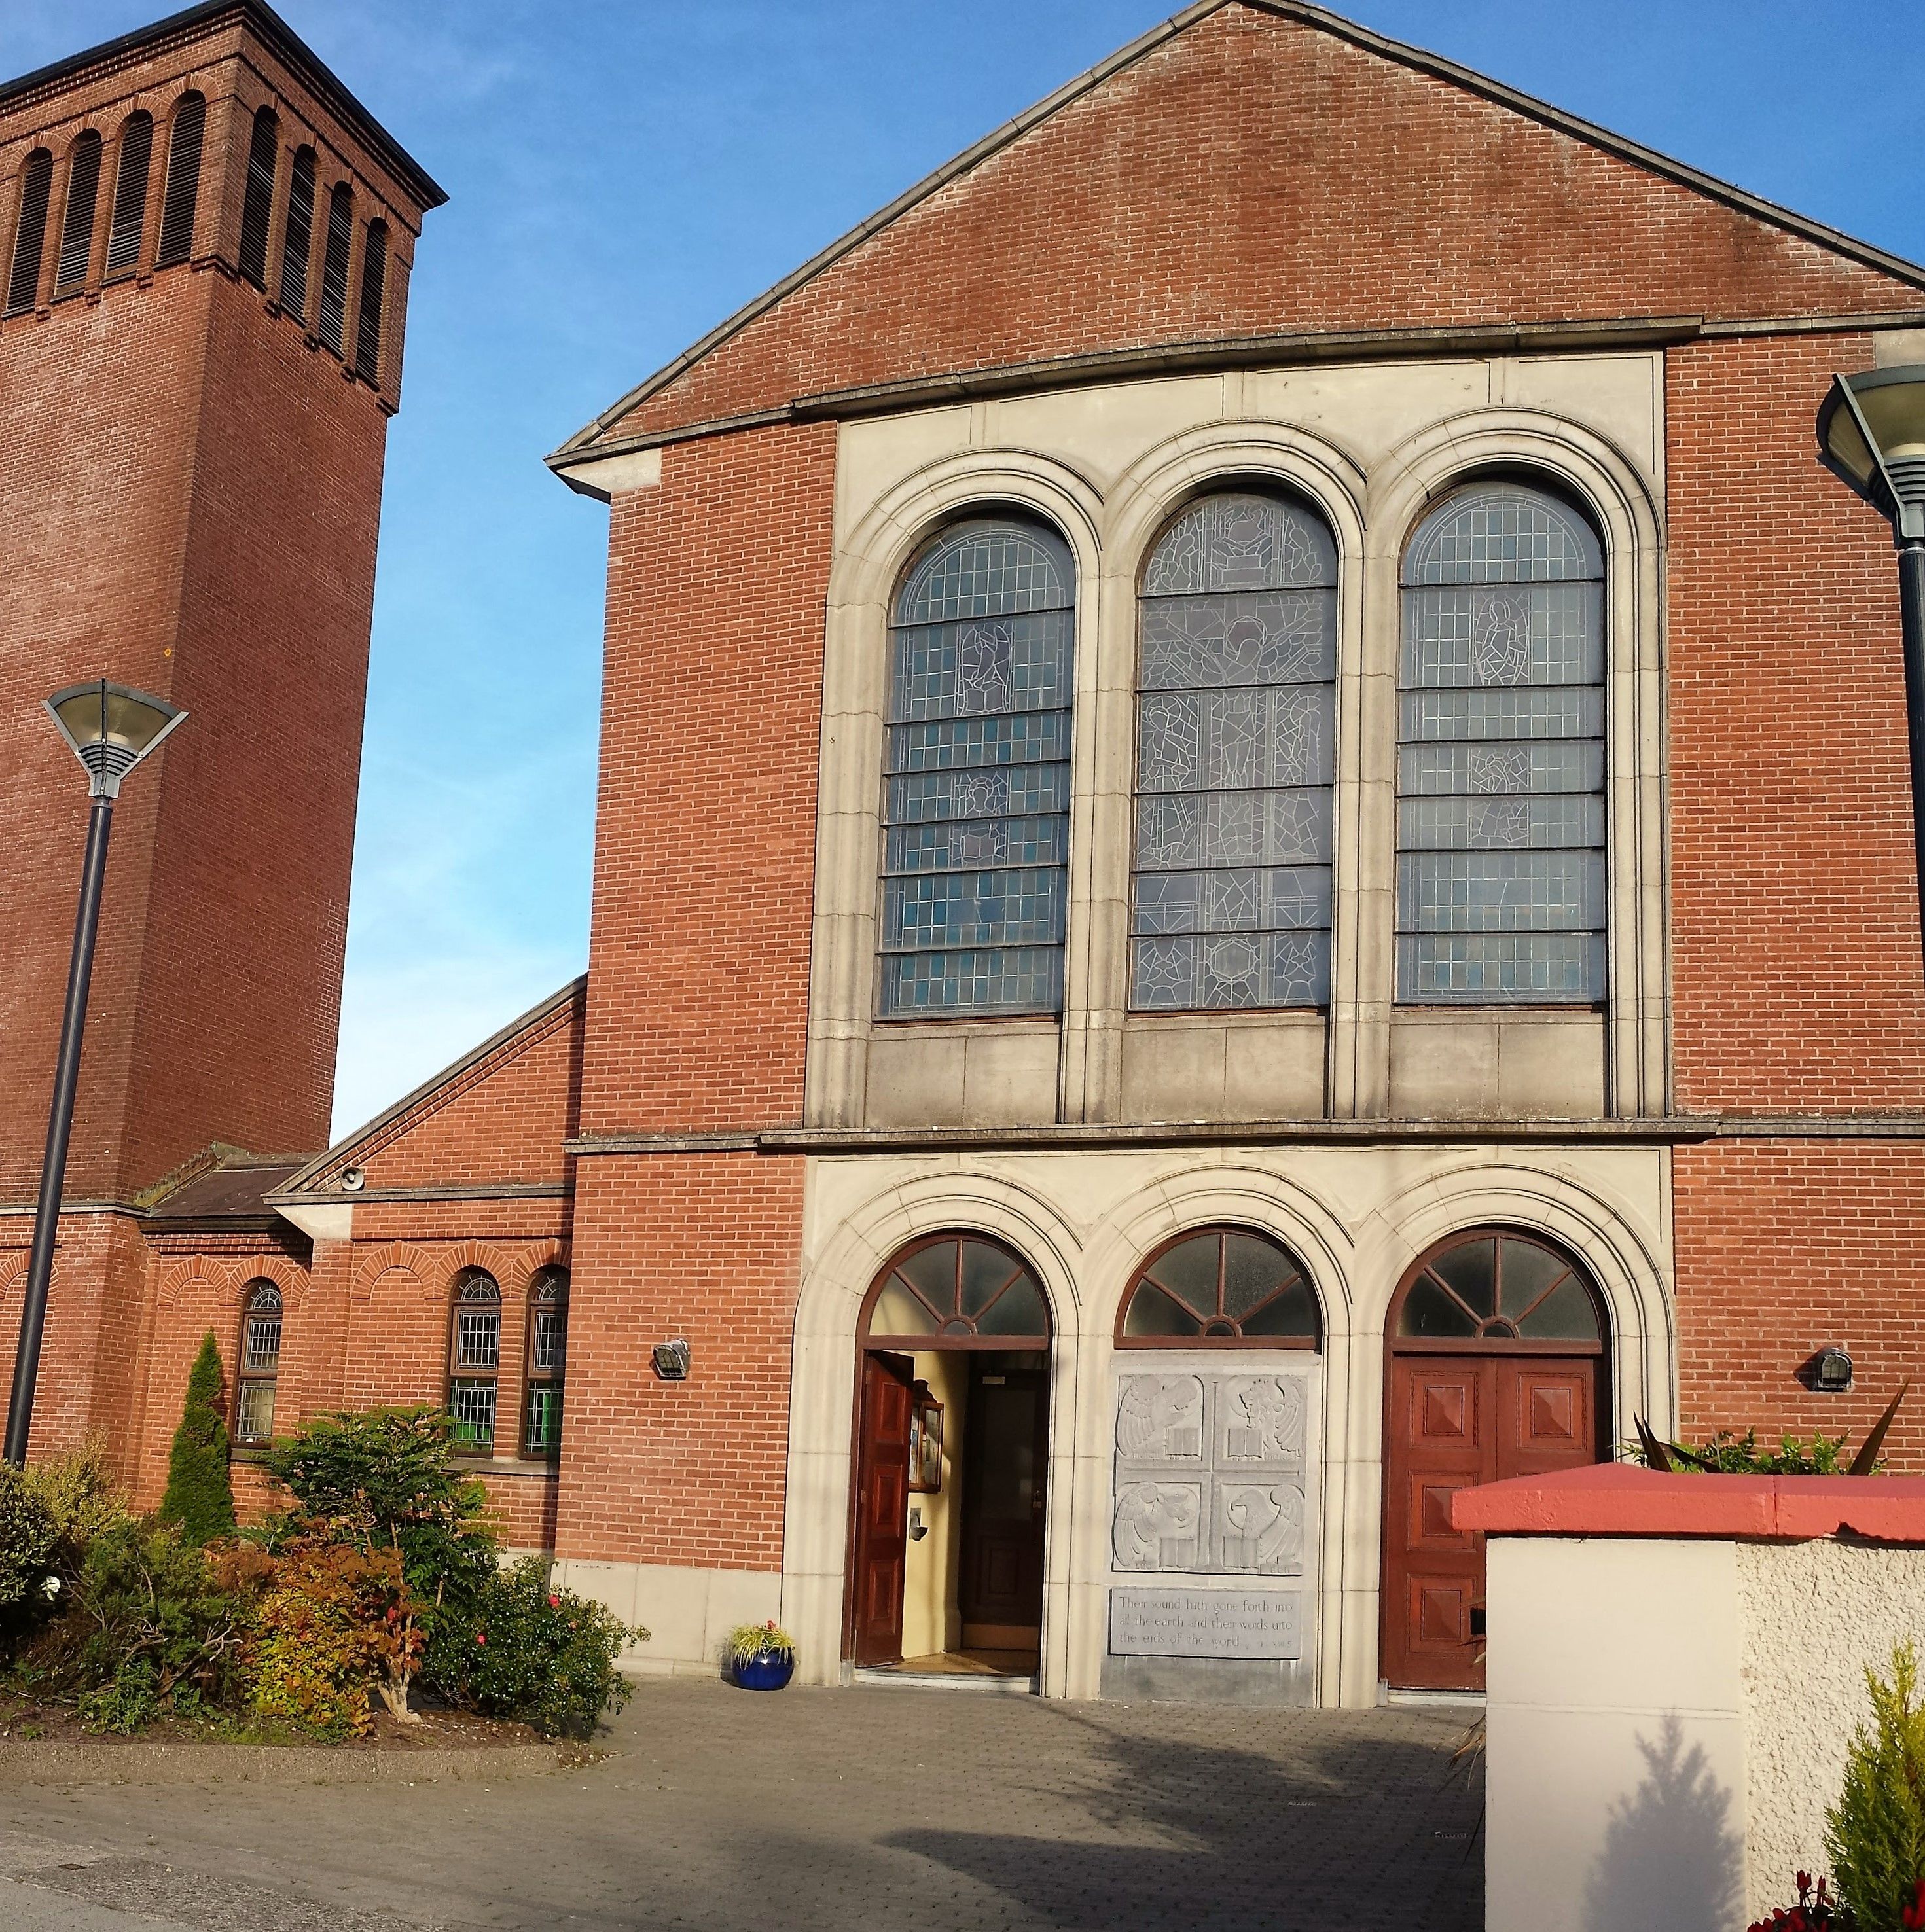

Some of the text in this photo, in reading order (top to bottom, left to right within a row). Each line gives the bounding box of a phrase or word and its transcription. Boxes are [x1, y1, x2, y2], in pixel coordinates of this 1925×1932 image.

[1119, 1596, 1147, 1609] Their
[1151, 1598, 1180, 1609] sound
[1187, 1598, 1208, 1610] hath
[1213, 1603, 1238, 1615] gone
[1243, 1600, 1269, 1612] forth
[1119, 1614, 1129, 1625] all
[1134, 1615, 1151, 1626] the
[1212, 1617, 1236, 1629] their
[1119, 1632, 1137, 1643] the
[1143, 1632, 1164, 1643] ends
[1170, 1633, 1181, 1644] of
[1188, 1633, 1205, 1645] the
